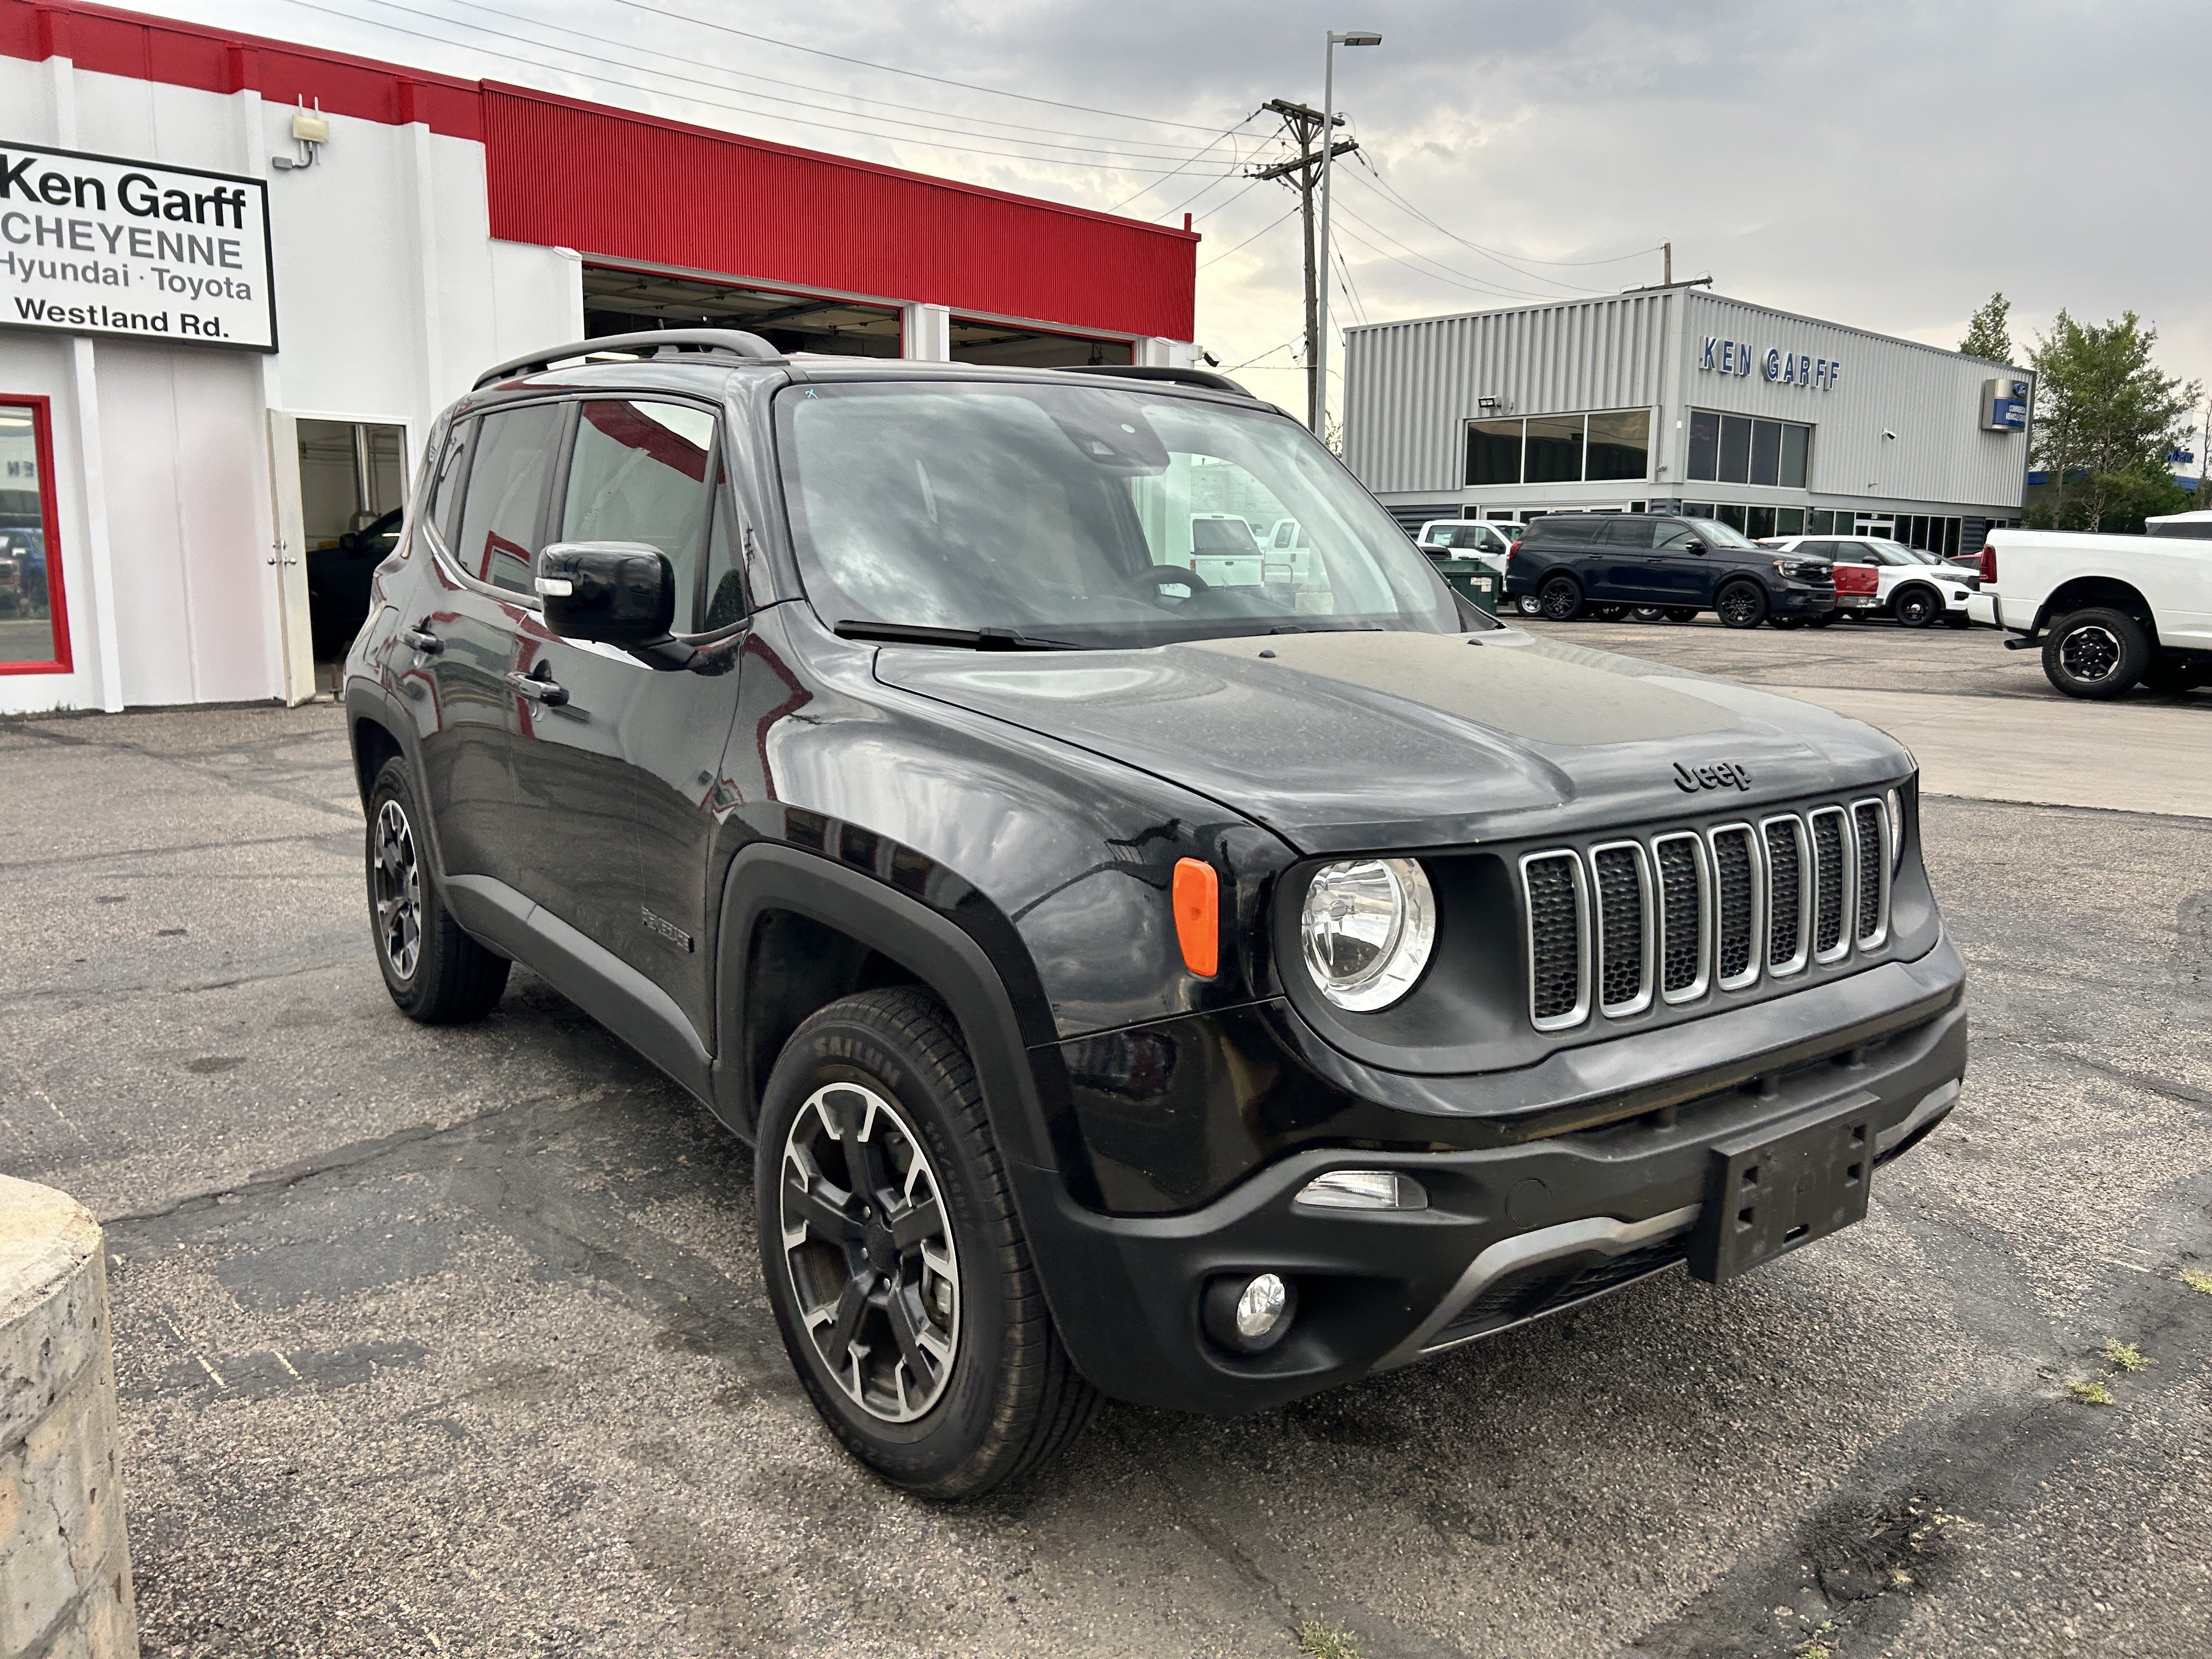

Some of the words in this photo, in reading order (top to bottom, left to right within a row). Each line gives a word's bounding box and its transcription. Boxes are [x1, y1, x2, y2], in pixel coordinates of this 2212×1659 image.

[0, 154, 106, 211] Ken
[117, 173, 246, 229] Garff
[1, 212, 243, 269] CHEYENNE
[151, 267, 252, 301] Toyota
[15, 297, 168, 333] Westland
[180, 314, 229, 338] Rd.
[1701, 336, 1752, 376] KEN
[1763, 348, 1840, 391] GARFF
[1673, 762, 1752, 793] Jeep
